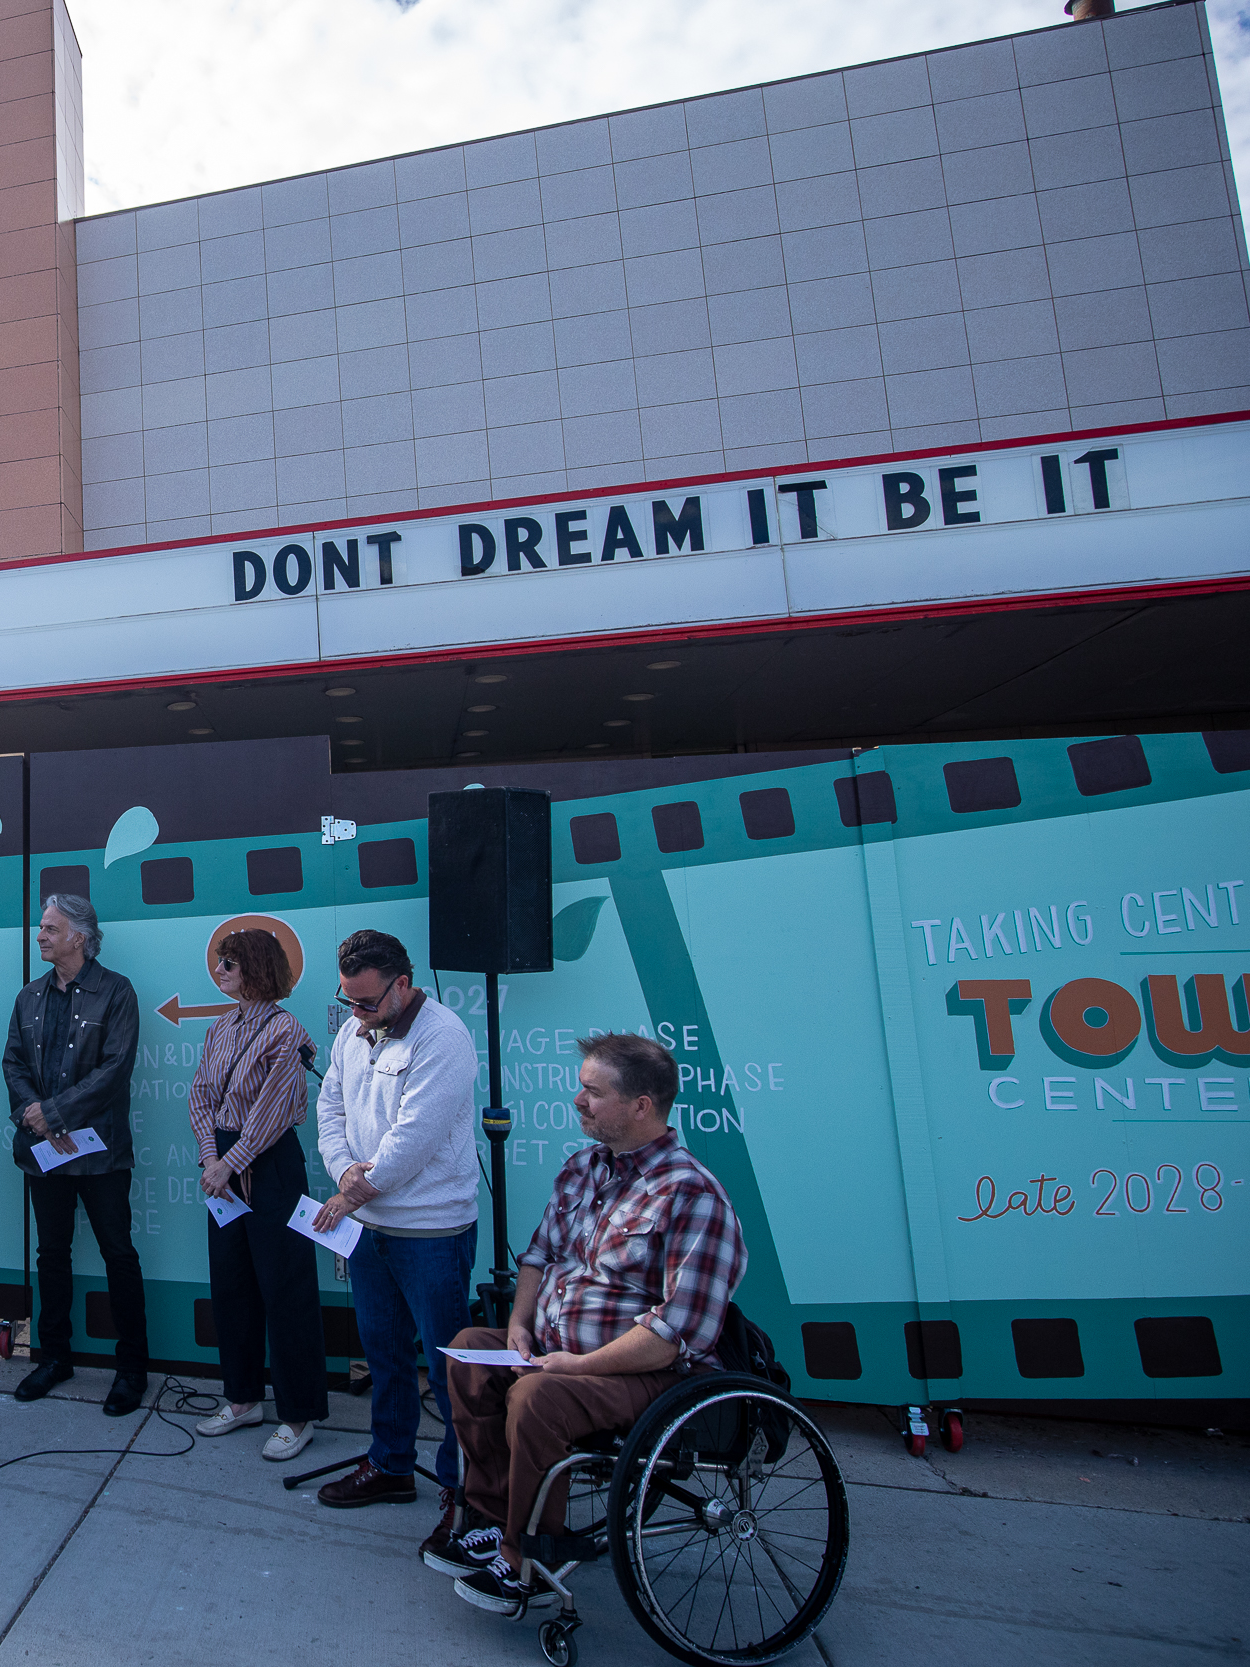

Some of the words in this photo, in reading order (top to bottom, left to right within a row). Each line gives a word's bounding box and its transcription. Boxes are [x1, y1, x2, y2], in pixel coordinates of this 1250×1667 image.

[232, 530, 402, 602] DONT
[458, 496, 705, 577] DREAM
[747, 480, 828, 545] IT
[882, 464, 981, 531] BE
[1040, 447, 1120, 515] IT
[911, 901, 1094, 966] TAKING
[945, 973, 1250, 1071] TOW
[678, 1062, 785, 1096] PHASE
[988, 1076, 1250, 1111] CENTE
[957, 1175, 1075, 1222] late
